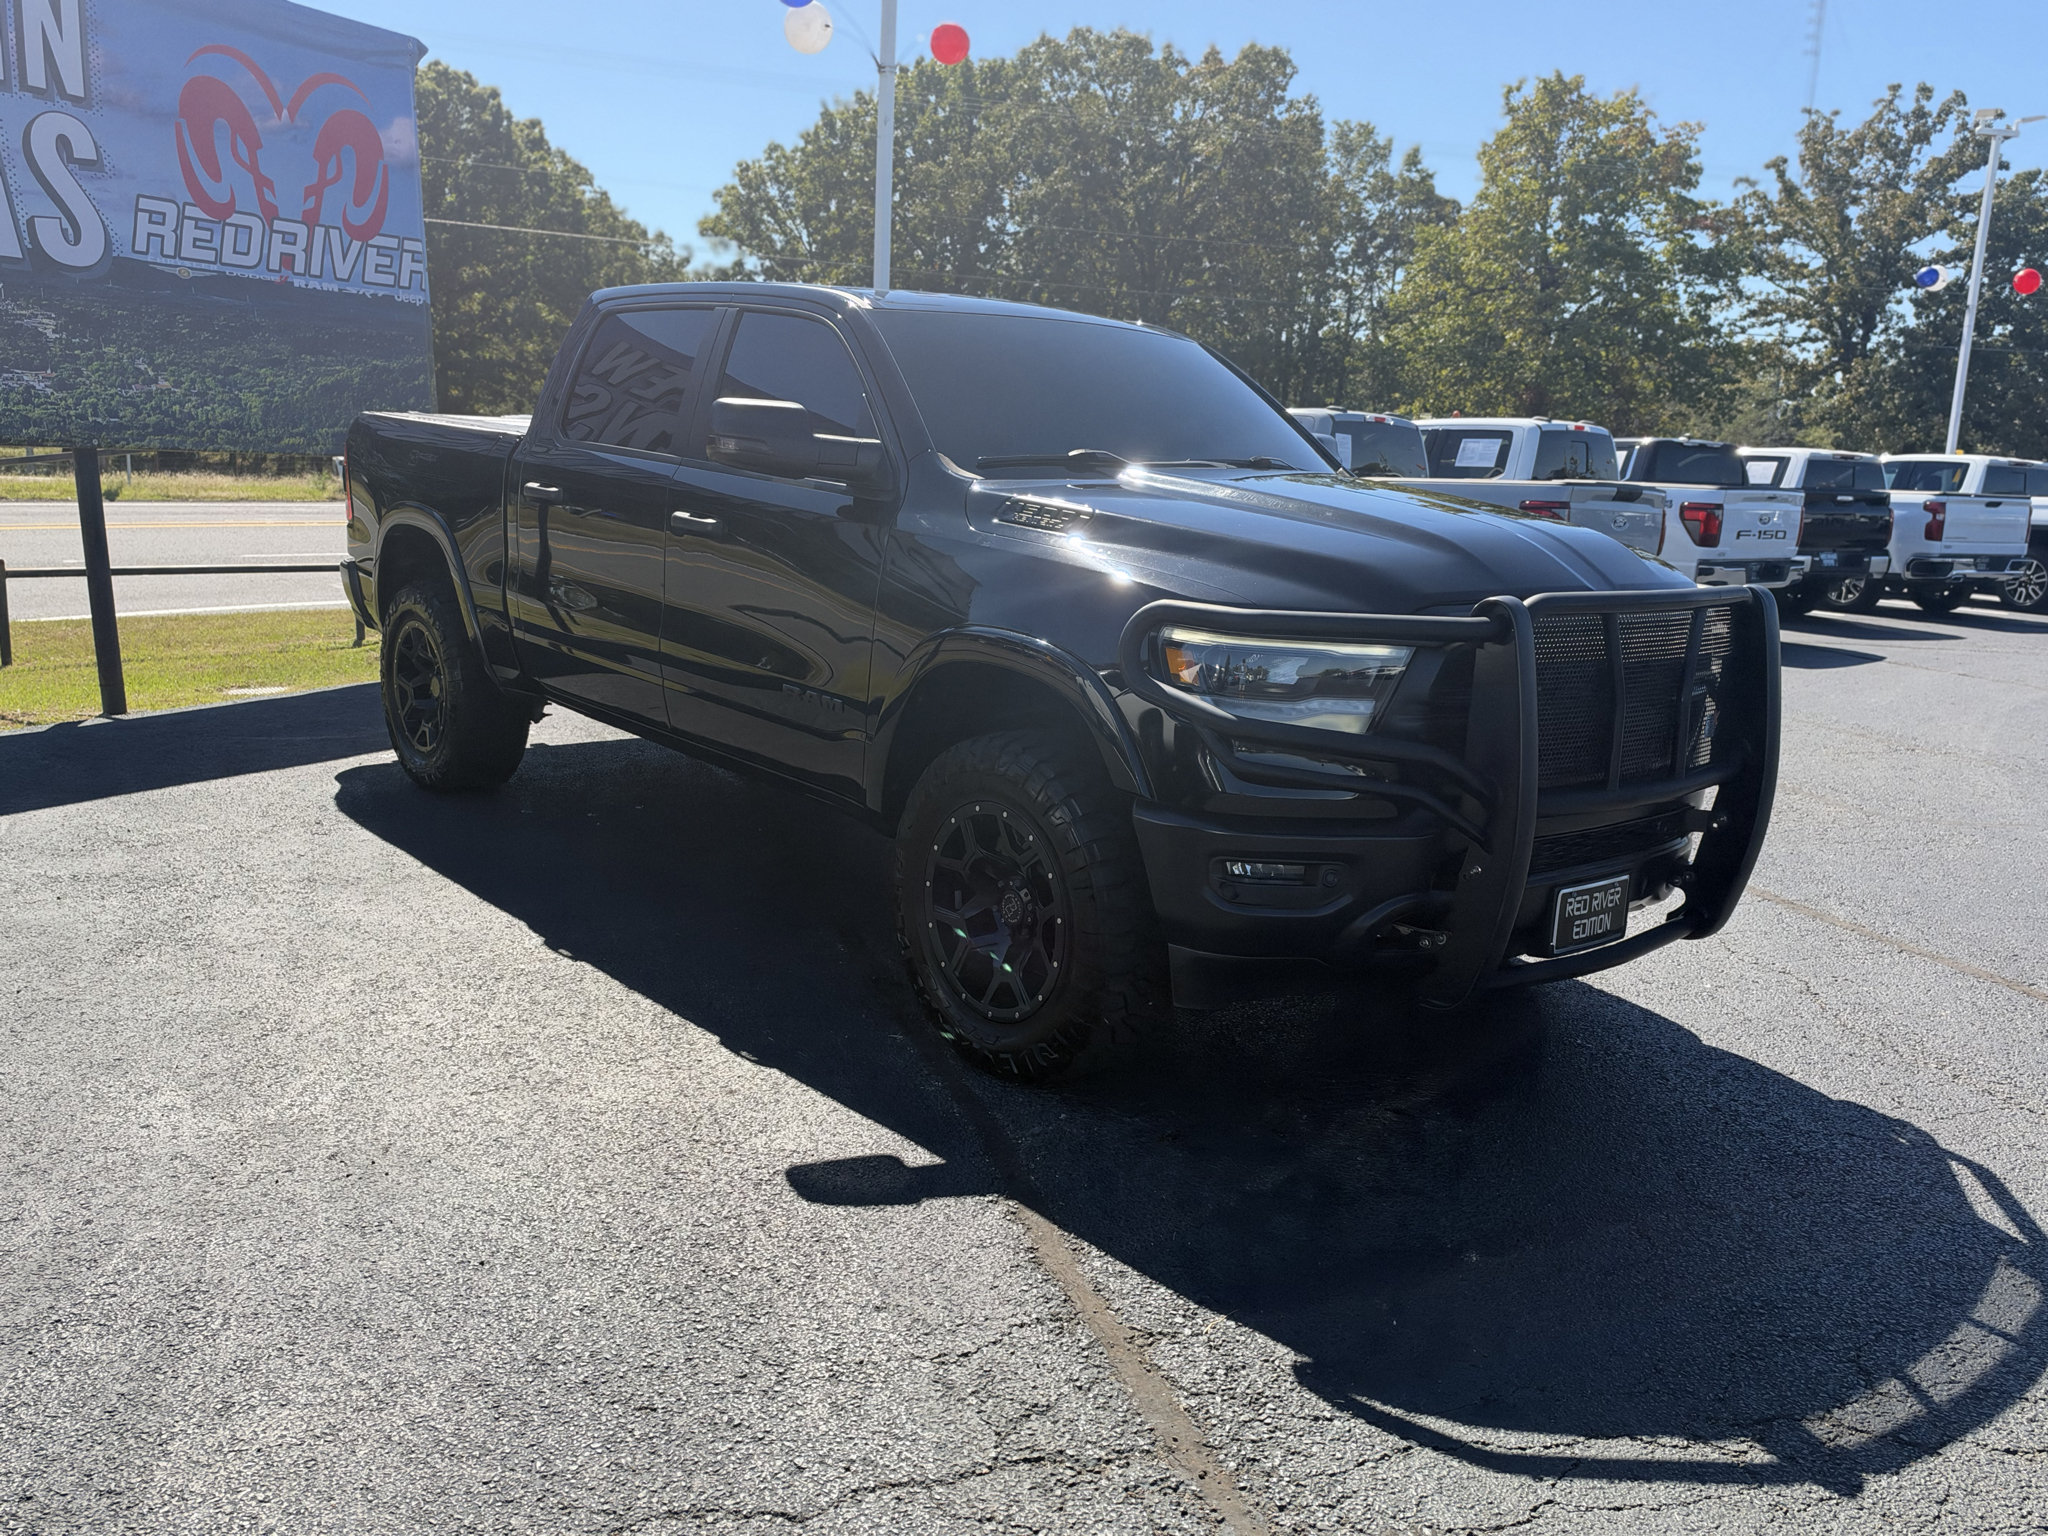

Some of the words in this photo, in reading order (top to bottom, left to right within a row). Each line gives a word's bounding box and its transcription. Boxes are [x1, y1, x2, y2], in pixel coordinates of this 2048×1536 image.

[293, 278, 339, 292] RAM
[1736, 530, 1787, 540] F-150
[1565, 894, 1590, 918] RED
[1591, 887, 1622, 912] RIVER
[1572, 912, 1612, 940] EDITION
